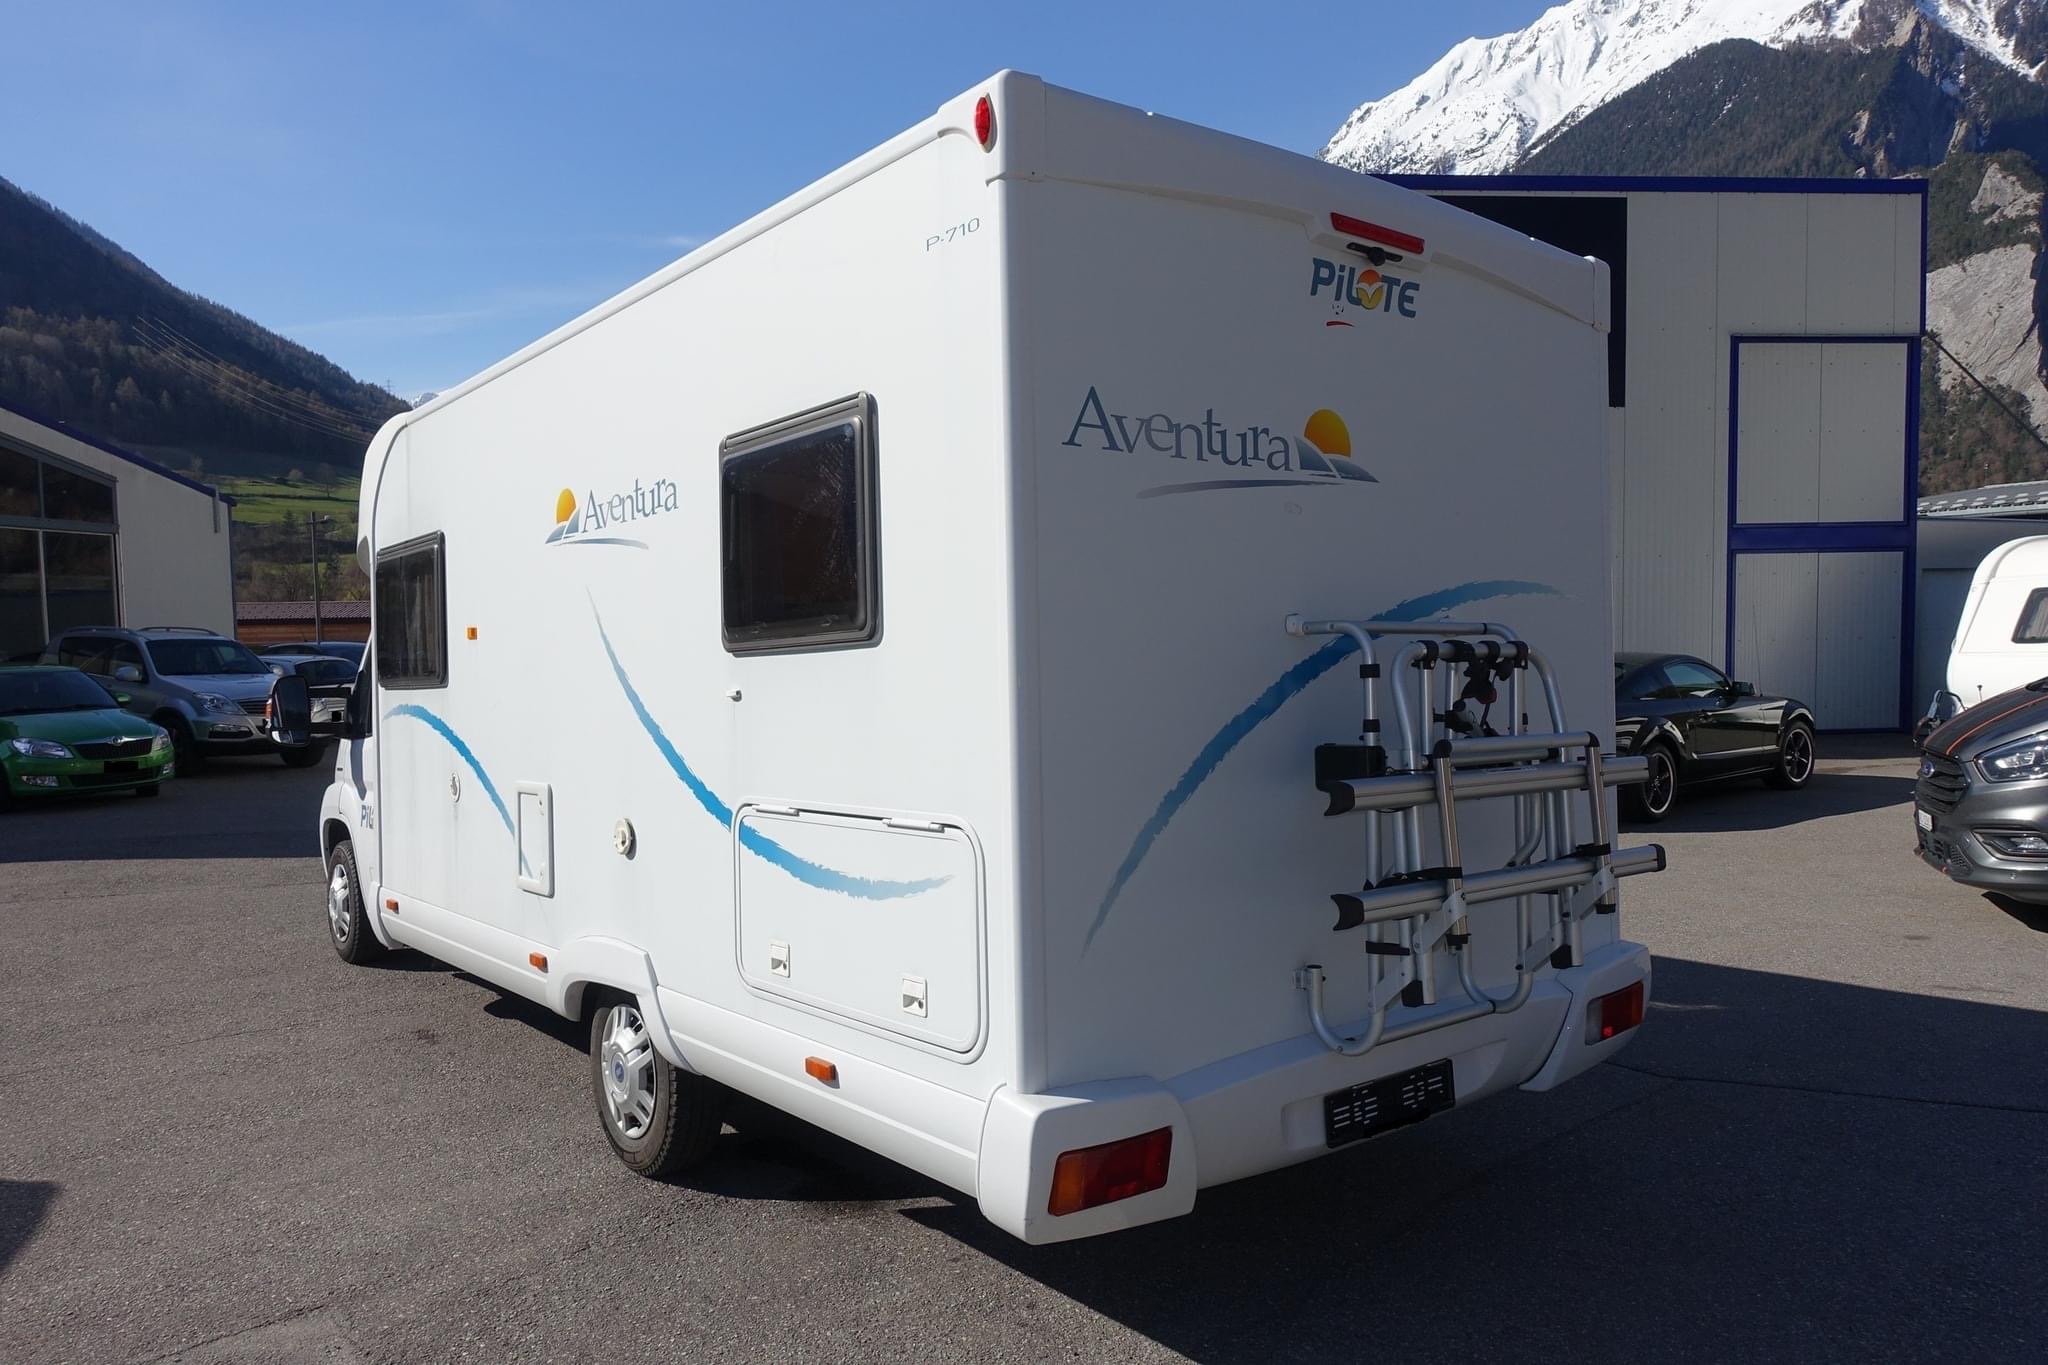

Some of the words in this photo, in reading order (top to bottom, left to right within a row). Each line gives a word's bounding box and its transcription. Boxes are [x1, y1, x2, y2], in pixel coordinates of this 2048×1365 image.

[926, 217, 980, 252] P-710
[1061, 385, 1294, 472] Aventura
[581, 477, 679, 534] Aventura
